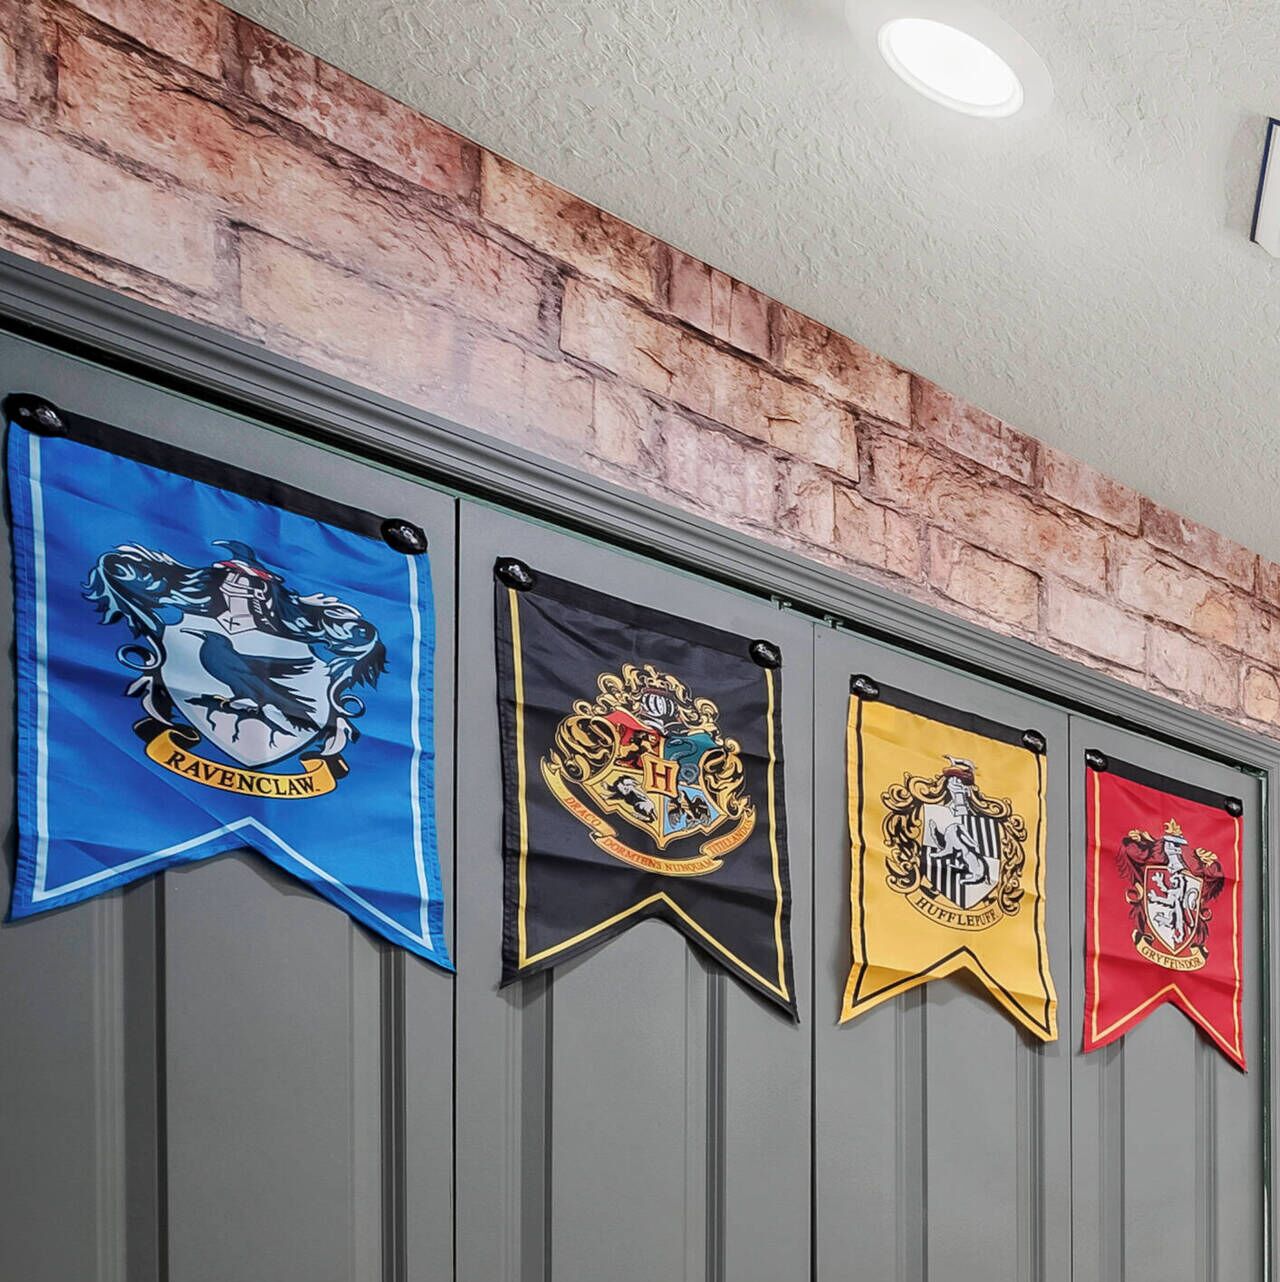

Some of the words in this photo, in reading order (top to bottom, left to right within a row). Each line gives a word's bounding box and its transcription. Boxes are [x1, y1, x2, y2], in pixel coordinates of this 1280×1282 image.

[165, 751, 315, 795] RAVENCLAW
[650, 762, 673, 794] H
[564, 796, 602, 827] DRACO
[915, 896, 998, 927] HUFFLEPUFF
[1141, 946, 1202, 969] GRYFFINDOR
